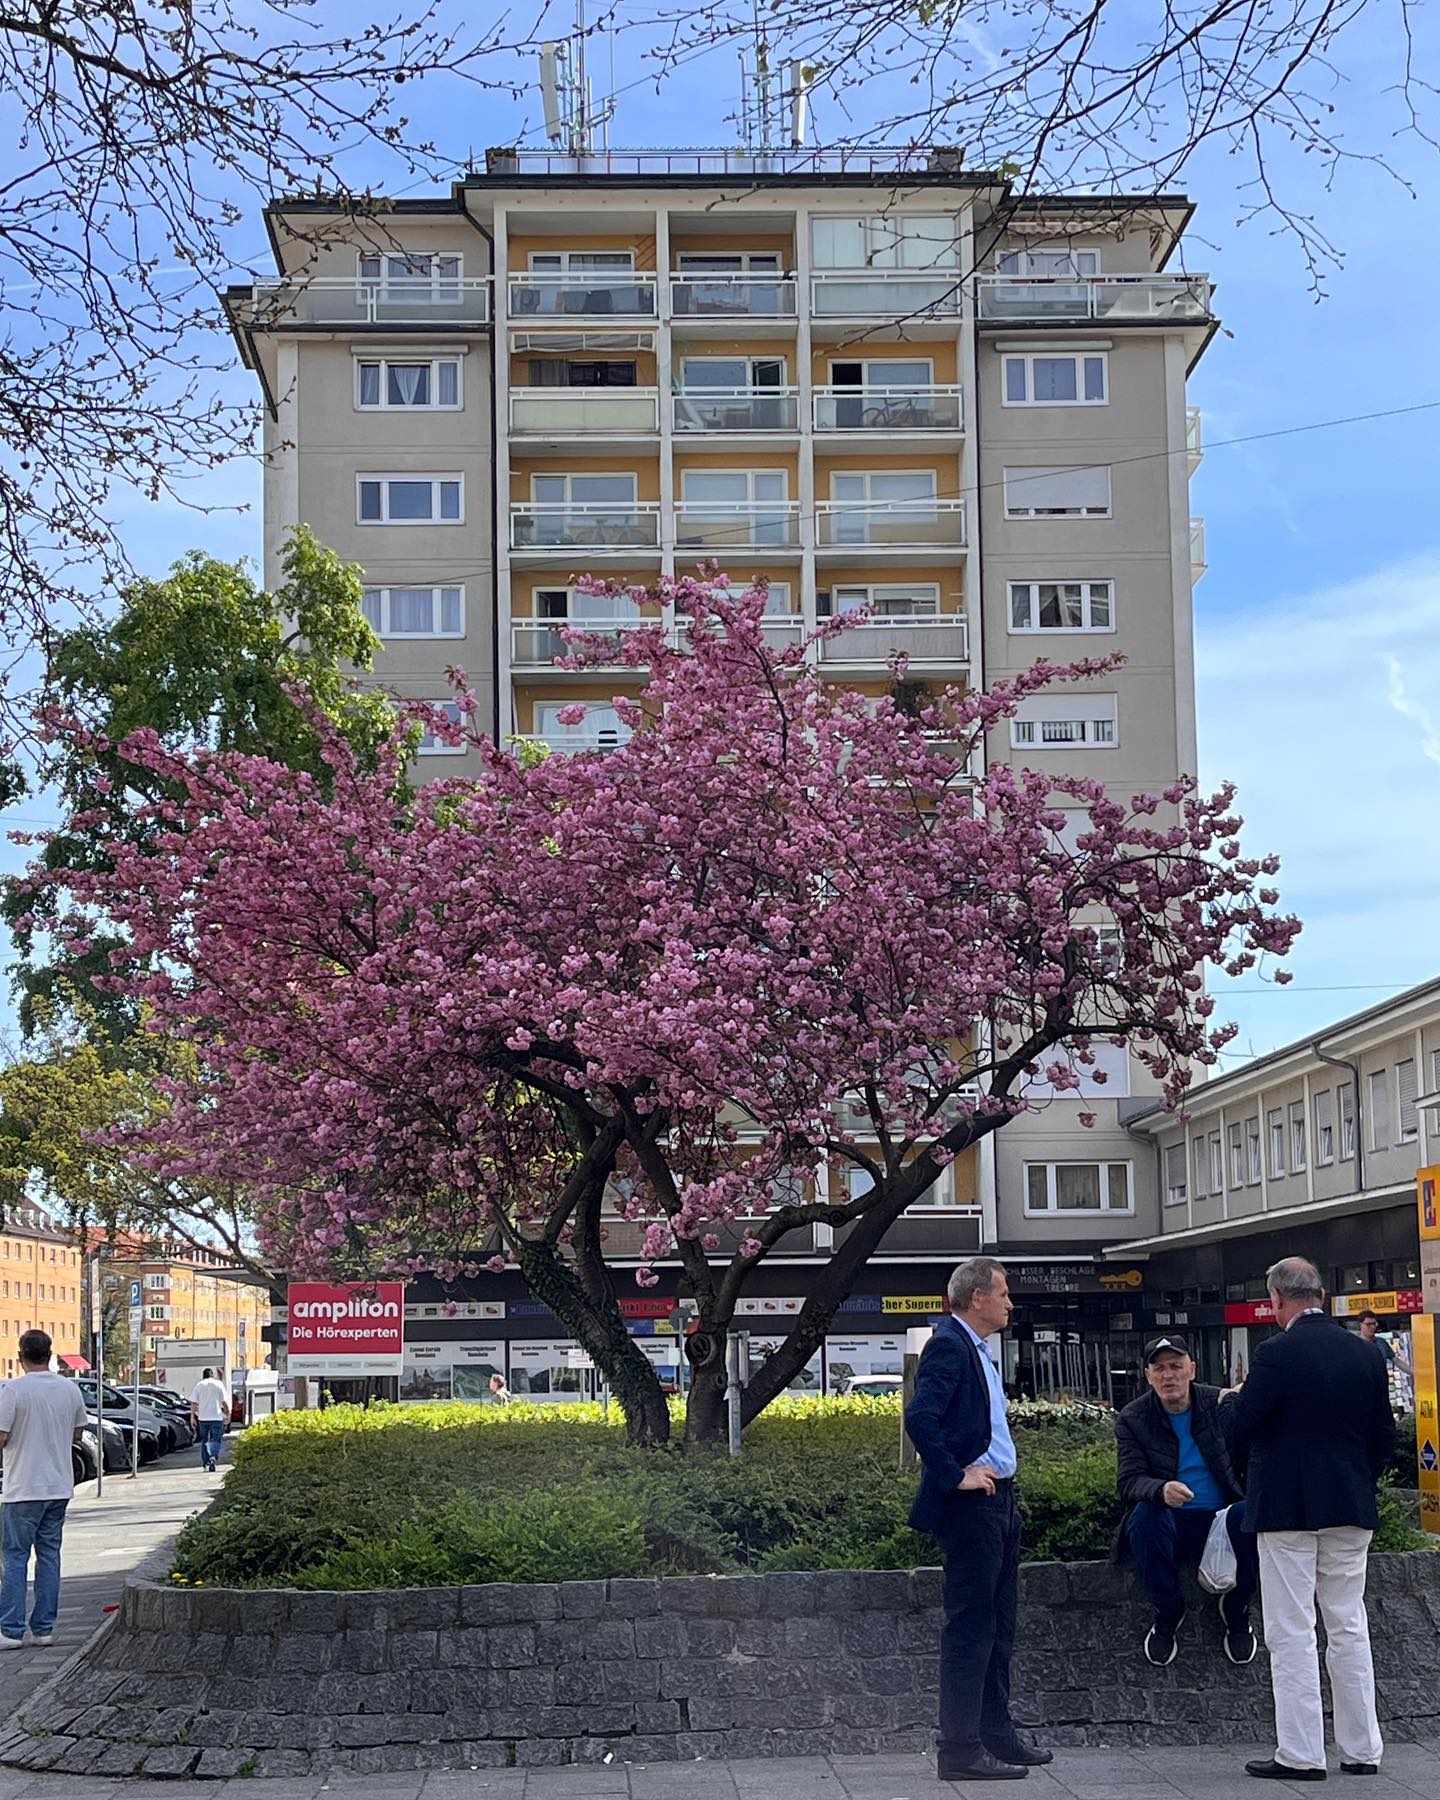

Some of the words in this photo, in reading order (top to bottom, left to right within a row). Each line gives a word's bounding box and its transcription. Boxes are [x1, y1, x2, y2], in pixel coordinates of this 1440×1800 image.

[293, 1298, 398, 1323] amplifon
[292, 1326, 313, 1338] Die
[317, 1326, 398, 1340] Hörexperten
